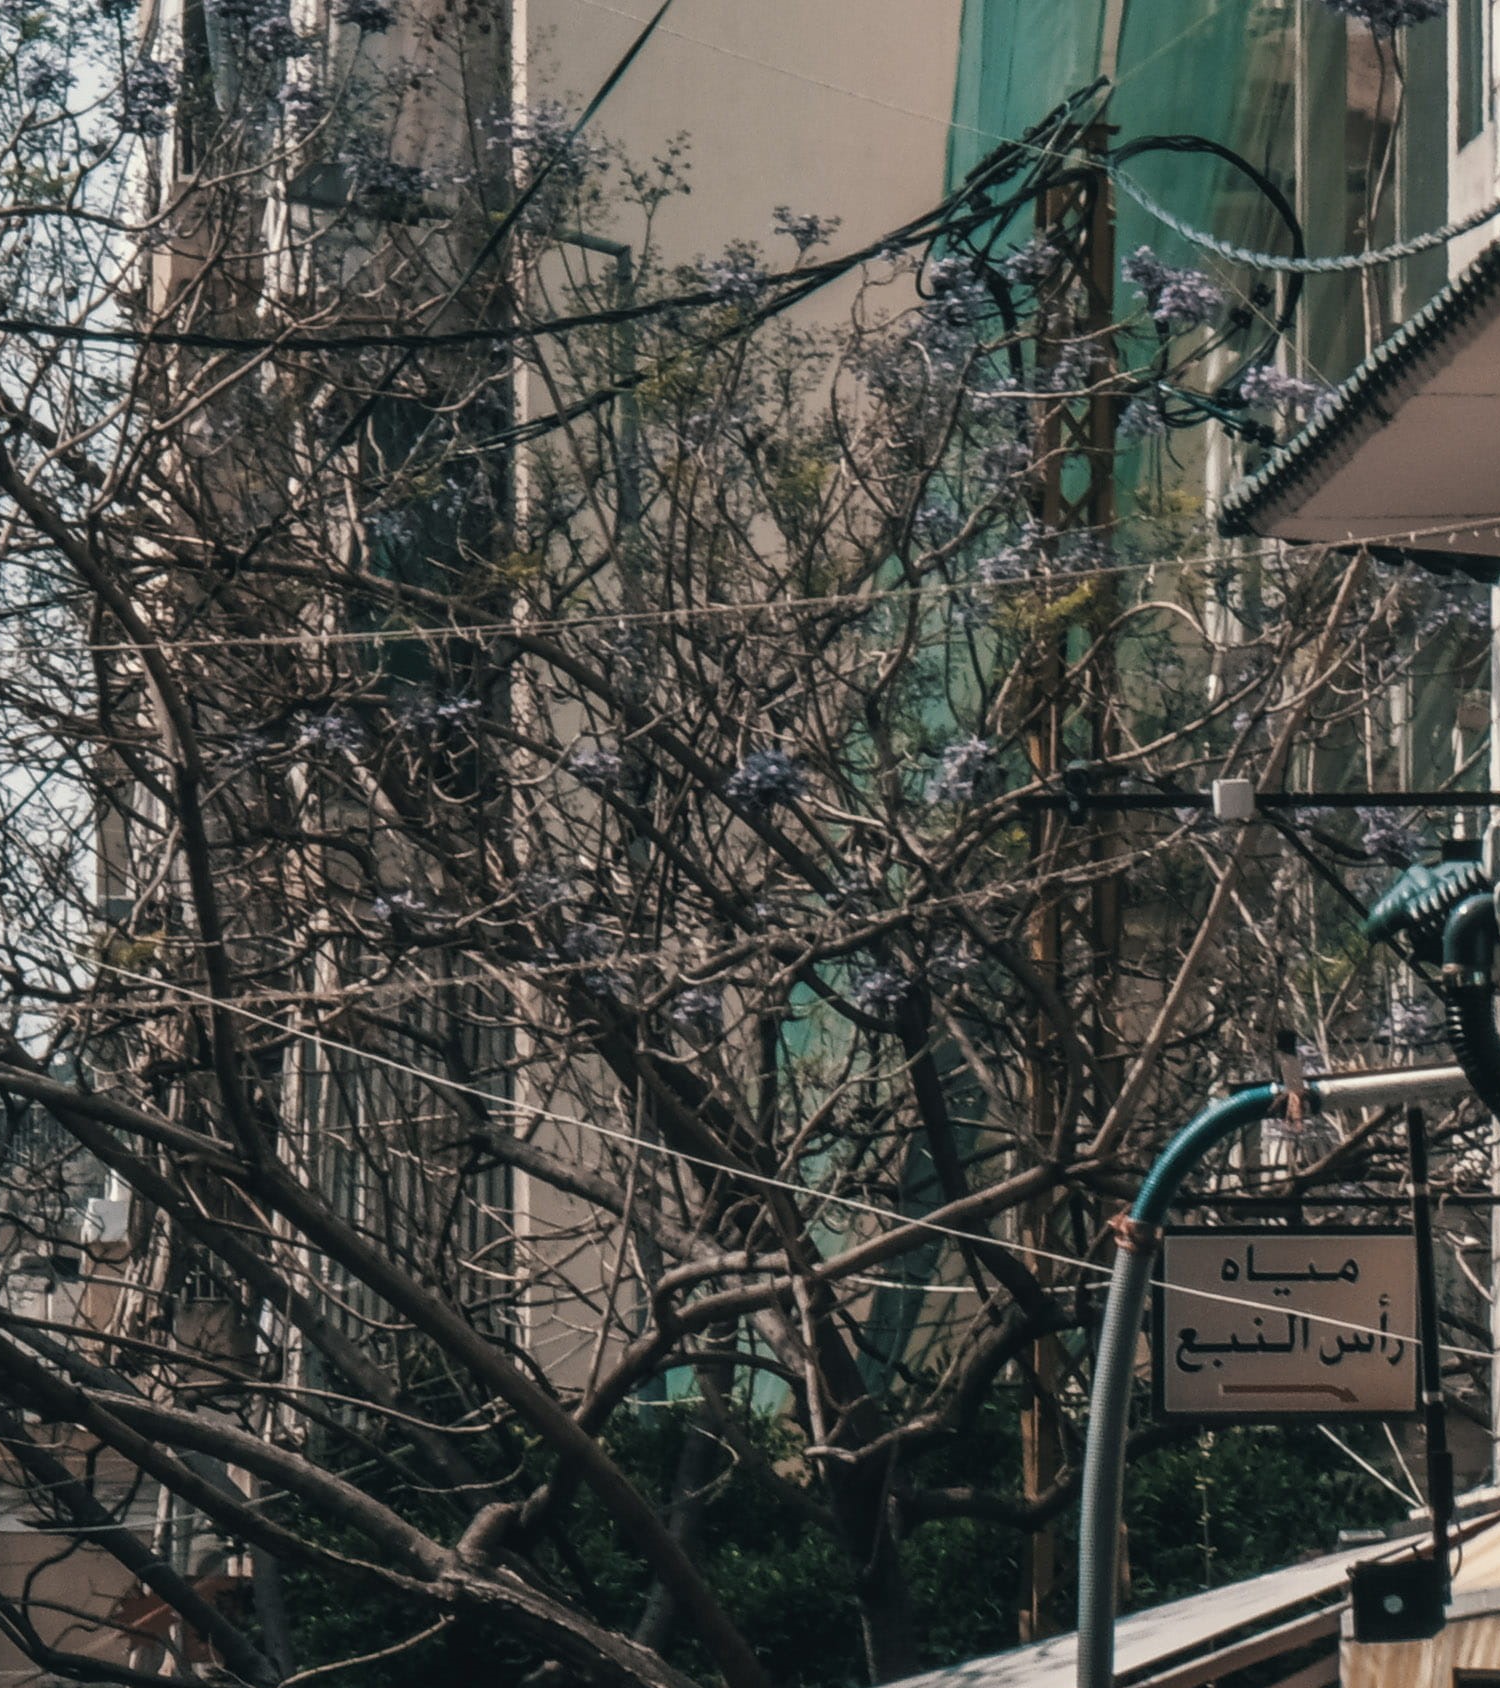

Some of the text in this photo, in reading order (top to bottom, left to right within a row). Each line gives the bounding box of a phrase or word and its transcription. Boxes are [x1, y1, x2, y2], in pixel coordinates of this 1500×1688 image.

[1220, 1244, 1360, 1297] مياه
[1175, 1294, 1405, 1372] رأس النبع
